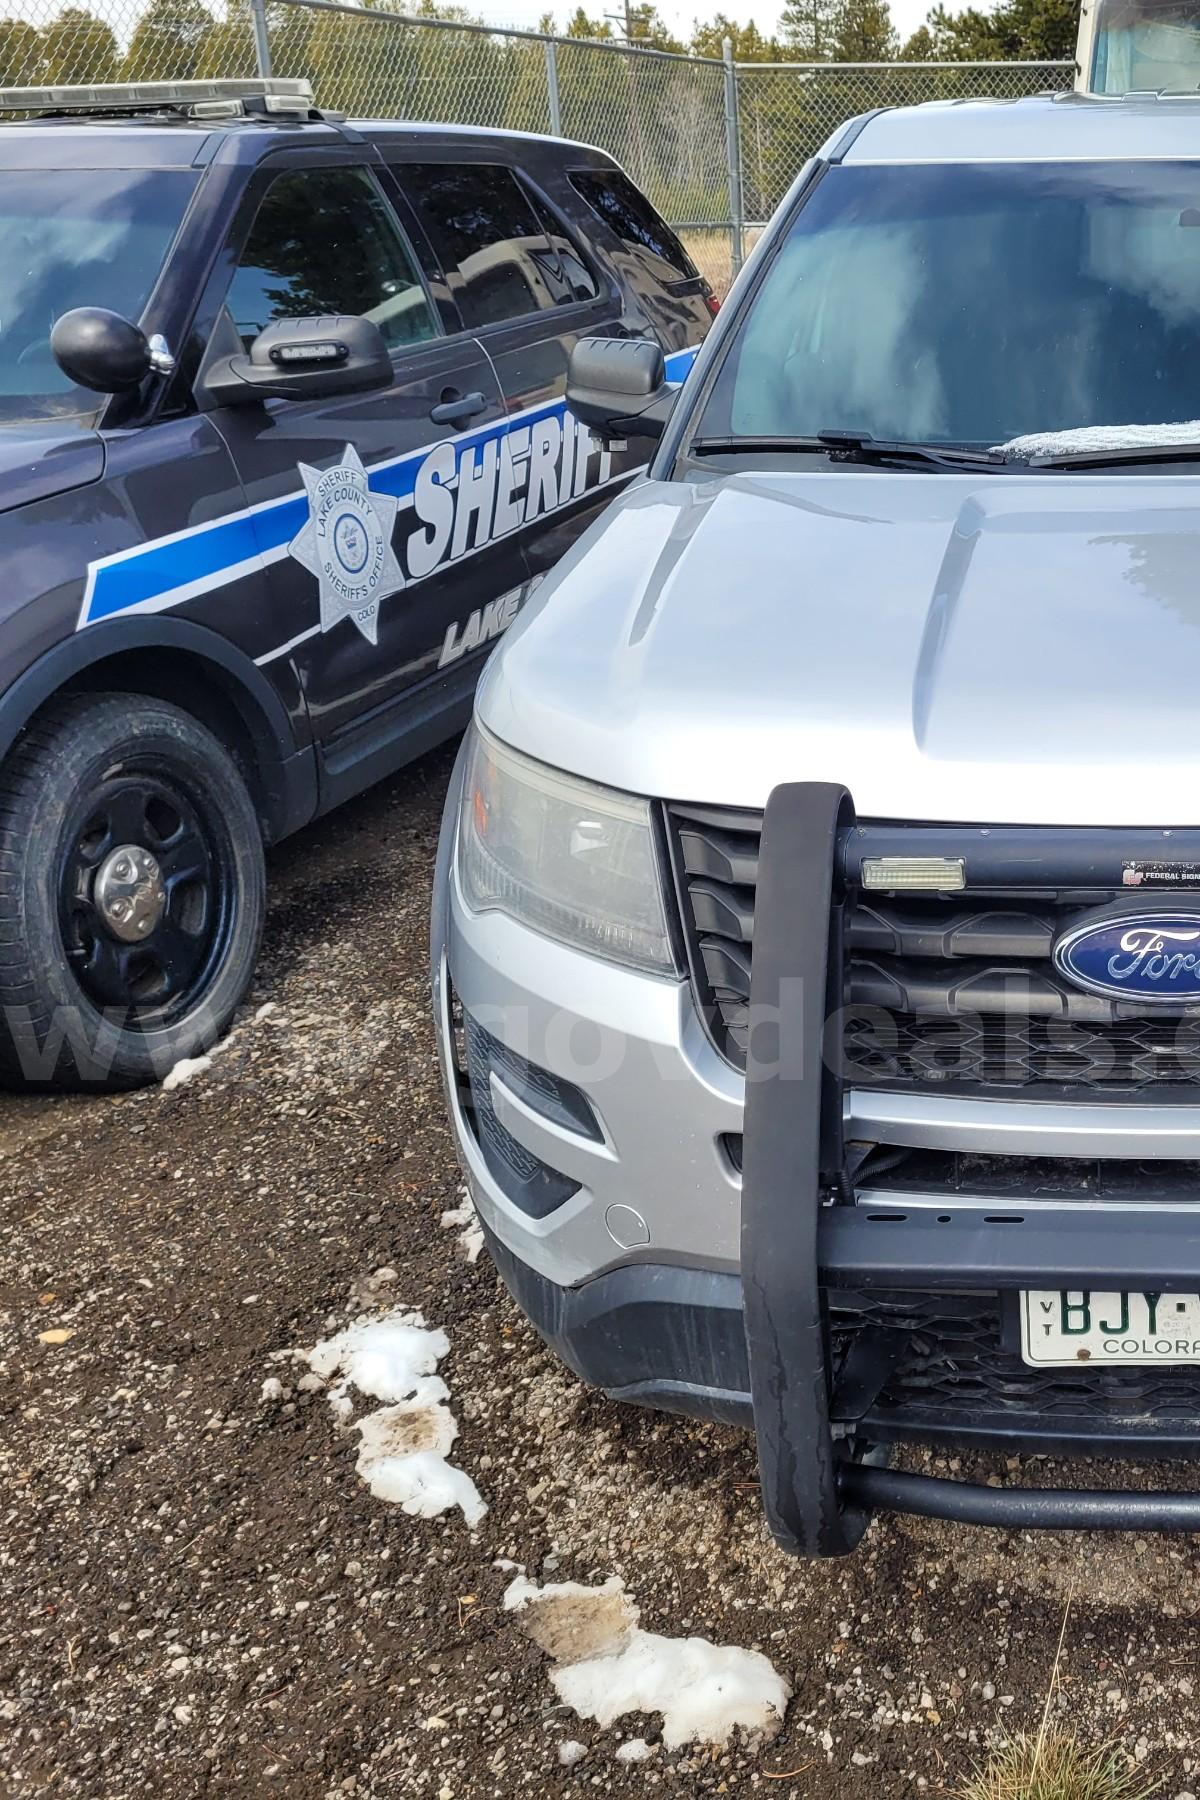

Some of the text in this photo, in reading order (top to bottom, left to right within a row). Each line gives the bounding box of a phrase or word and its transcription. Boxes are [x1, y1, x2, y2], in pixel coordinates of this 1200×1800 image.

[318, 470, 357, 498] SHERIFF
[318, 487, 373, 537] LAKE COUNTY
[369, 535, 384, 588] OFFICE
[357, 605, 376, 622] COLO
[436, 586, 523, 670] LAKE
[1145, 872, 1179, 880] FEDERAL
